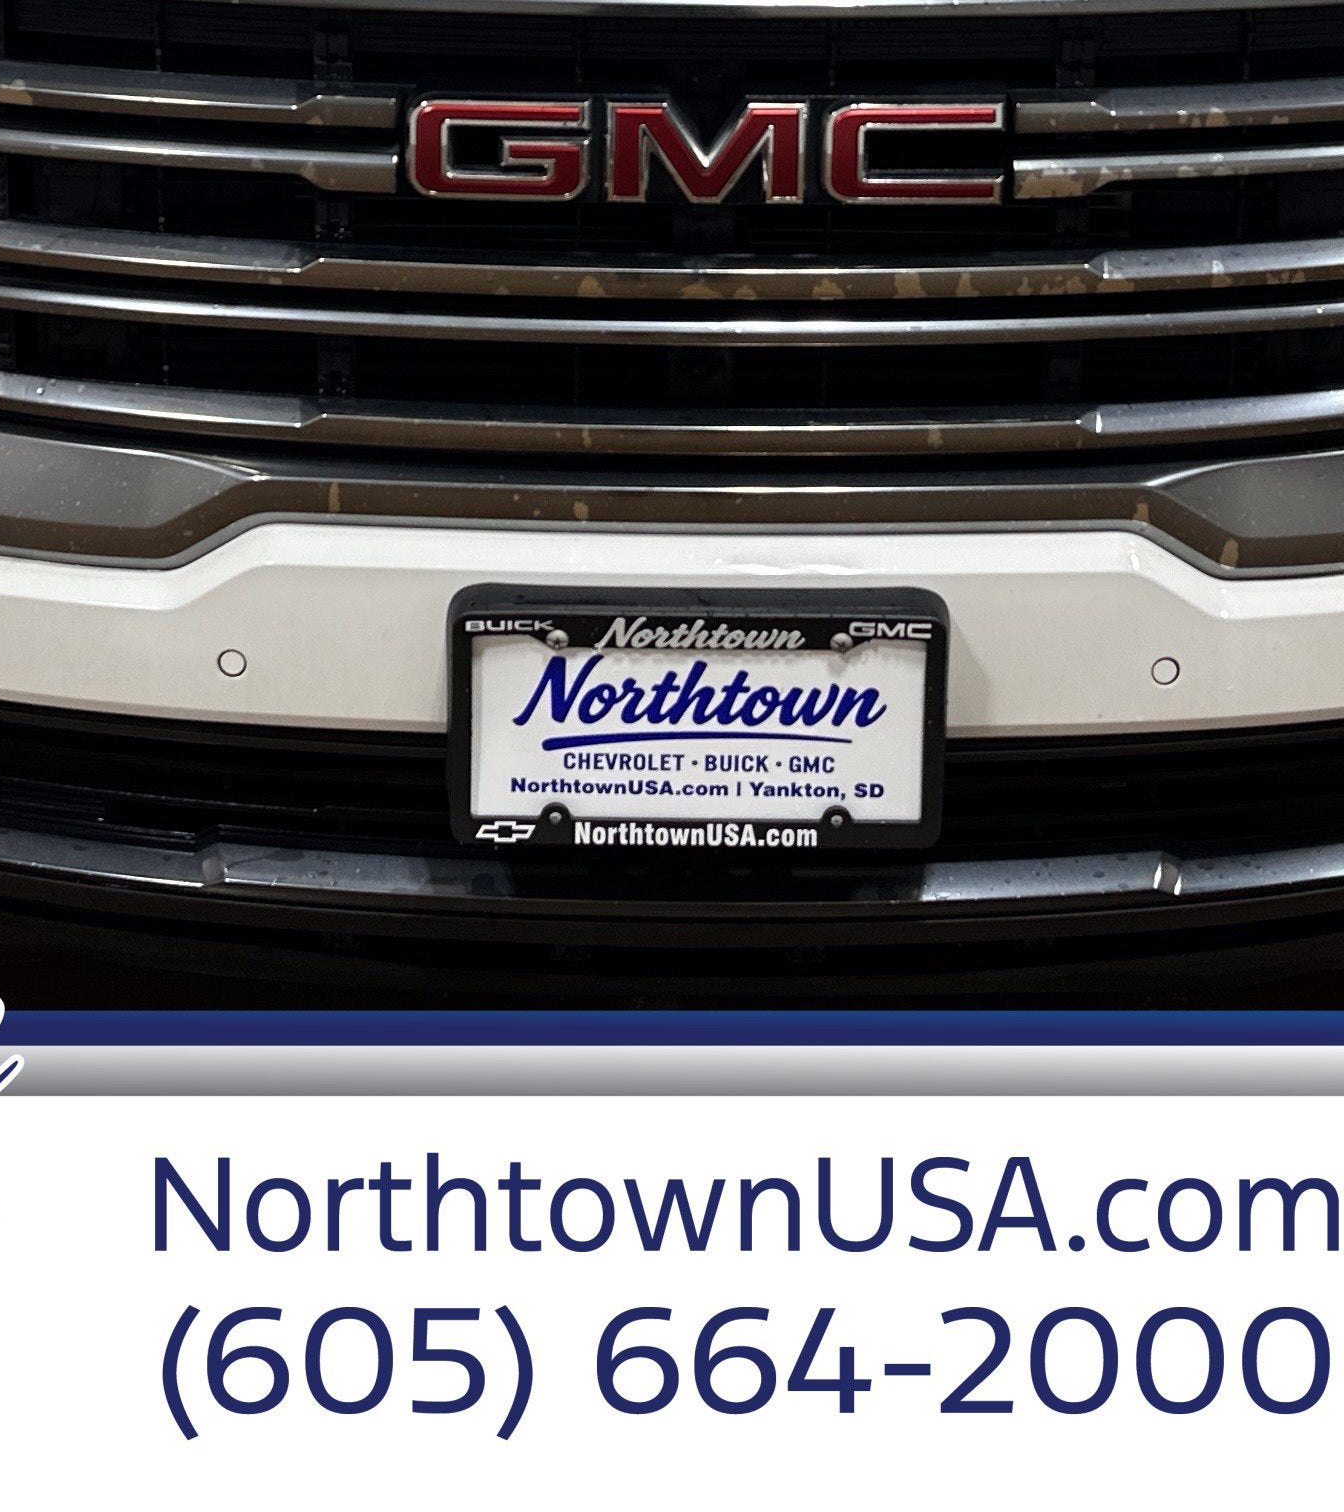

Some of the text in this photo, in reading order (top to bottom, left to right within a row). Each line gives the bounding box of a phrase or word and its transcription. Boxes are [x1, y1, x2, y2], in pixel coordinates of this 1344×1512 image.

[409, 94, 1005, 205] GMC
[464, 619, 555, 632] BUICK
[594, 616, 806, 650] Northtown
[848, 621, 933, 638] GMC
[513, 654, 887, 728] Northtown
[563, 753, 835, 774] CHEVROLET BUICK GMC
[510, 777, 885, 801] NorthtownUSA.com Yankton, SD
[574, 821, 818, 847] NorthtownUSA.com
